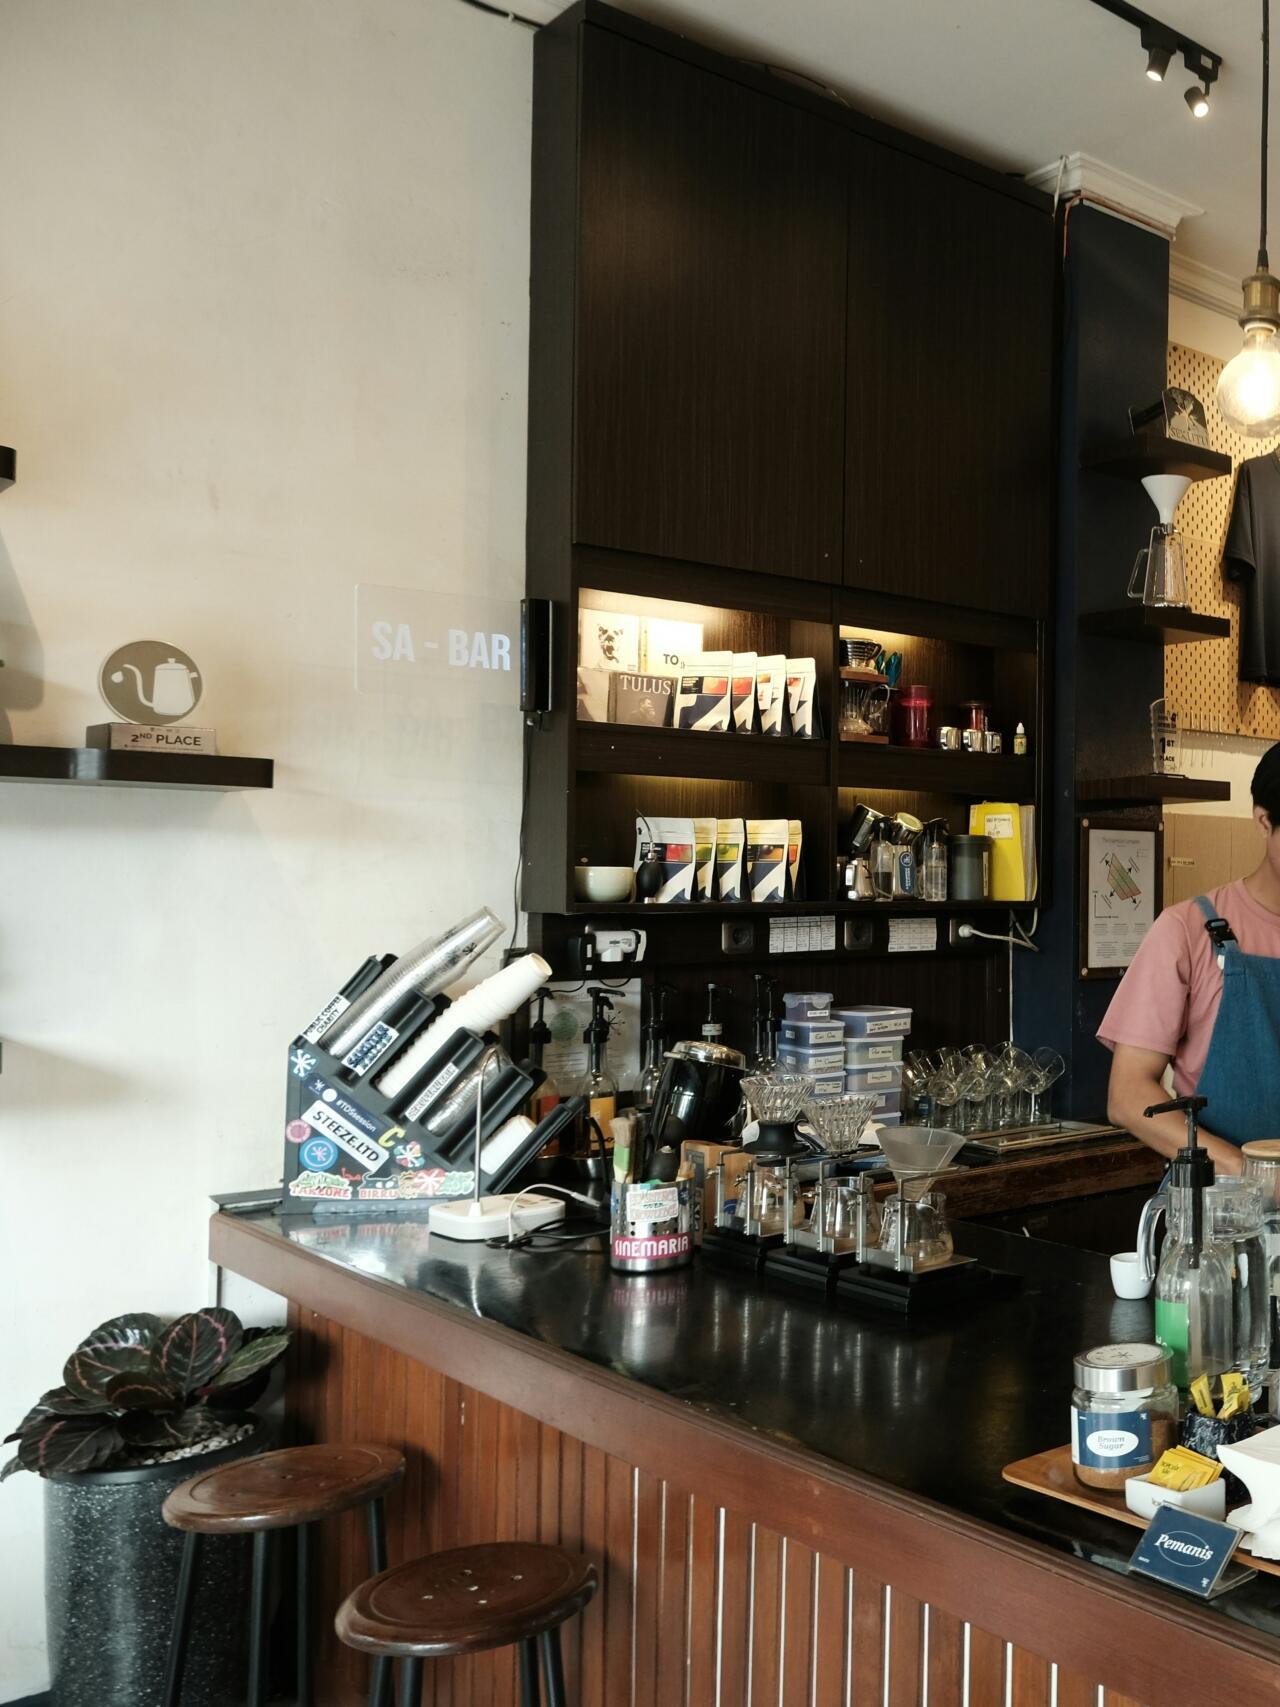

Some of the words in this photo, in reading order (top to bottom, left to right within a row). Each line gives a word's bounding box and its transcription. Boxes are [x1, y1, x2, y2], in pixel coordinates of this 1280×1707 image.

[371, 620, 416, 662] SA
[448, 629, 511, 671] BAR
[619, 674, 671, 695] TULUS
[156, 734, 202, 746] PLACE
[316, 1008, 340, 1034] CHARITY
[313, 1110, 379, 1163] STEEZE.LTD
[615, 1235, 689, 1257] SINEMARIA
[1098, 1442, 1125, 1451] Sugar
[1154, 1533, 1214, 1560] Pemanis
